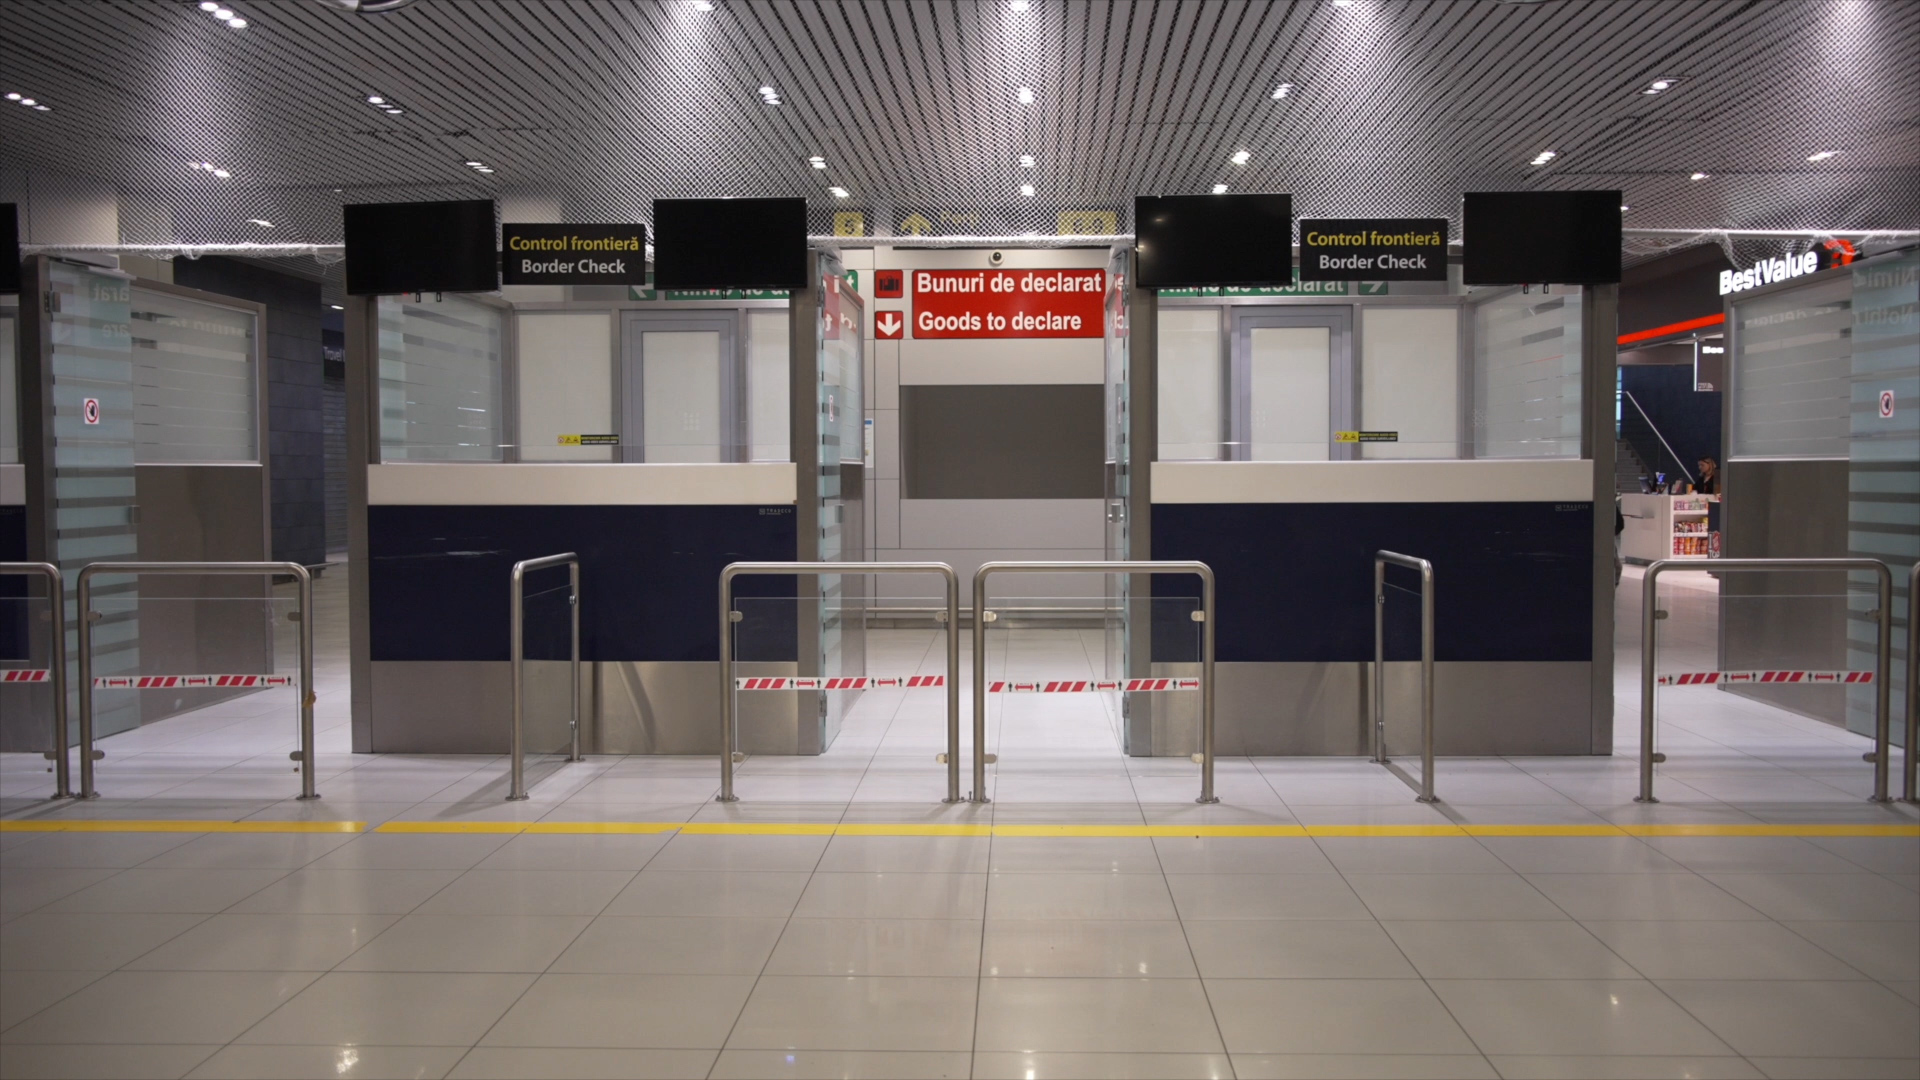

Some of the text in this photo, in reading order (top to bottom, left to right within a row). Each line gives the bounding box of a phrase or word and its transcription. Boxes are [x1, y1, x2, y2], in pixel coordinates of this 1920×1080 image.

[509, 236, 639, 251] Control frontieră
[1306, 231, 1441, 247] Control frontieră
[521, 258, 626, 274] Border Check
[1319, 254, 1427, 270] Border Check
[917, 272, 1102, 293] Bunuri de declarat
[918, 311, 1082, 331] Goods to declare
